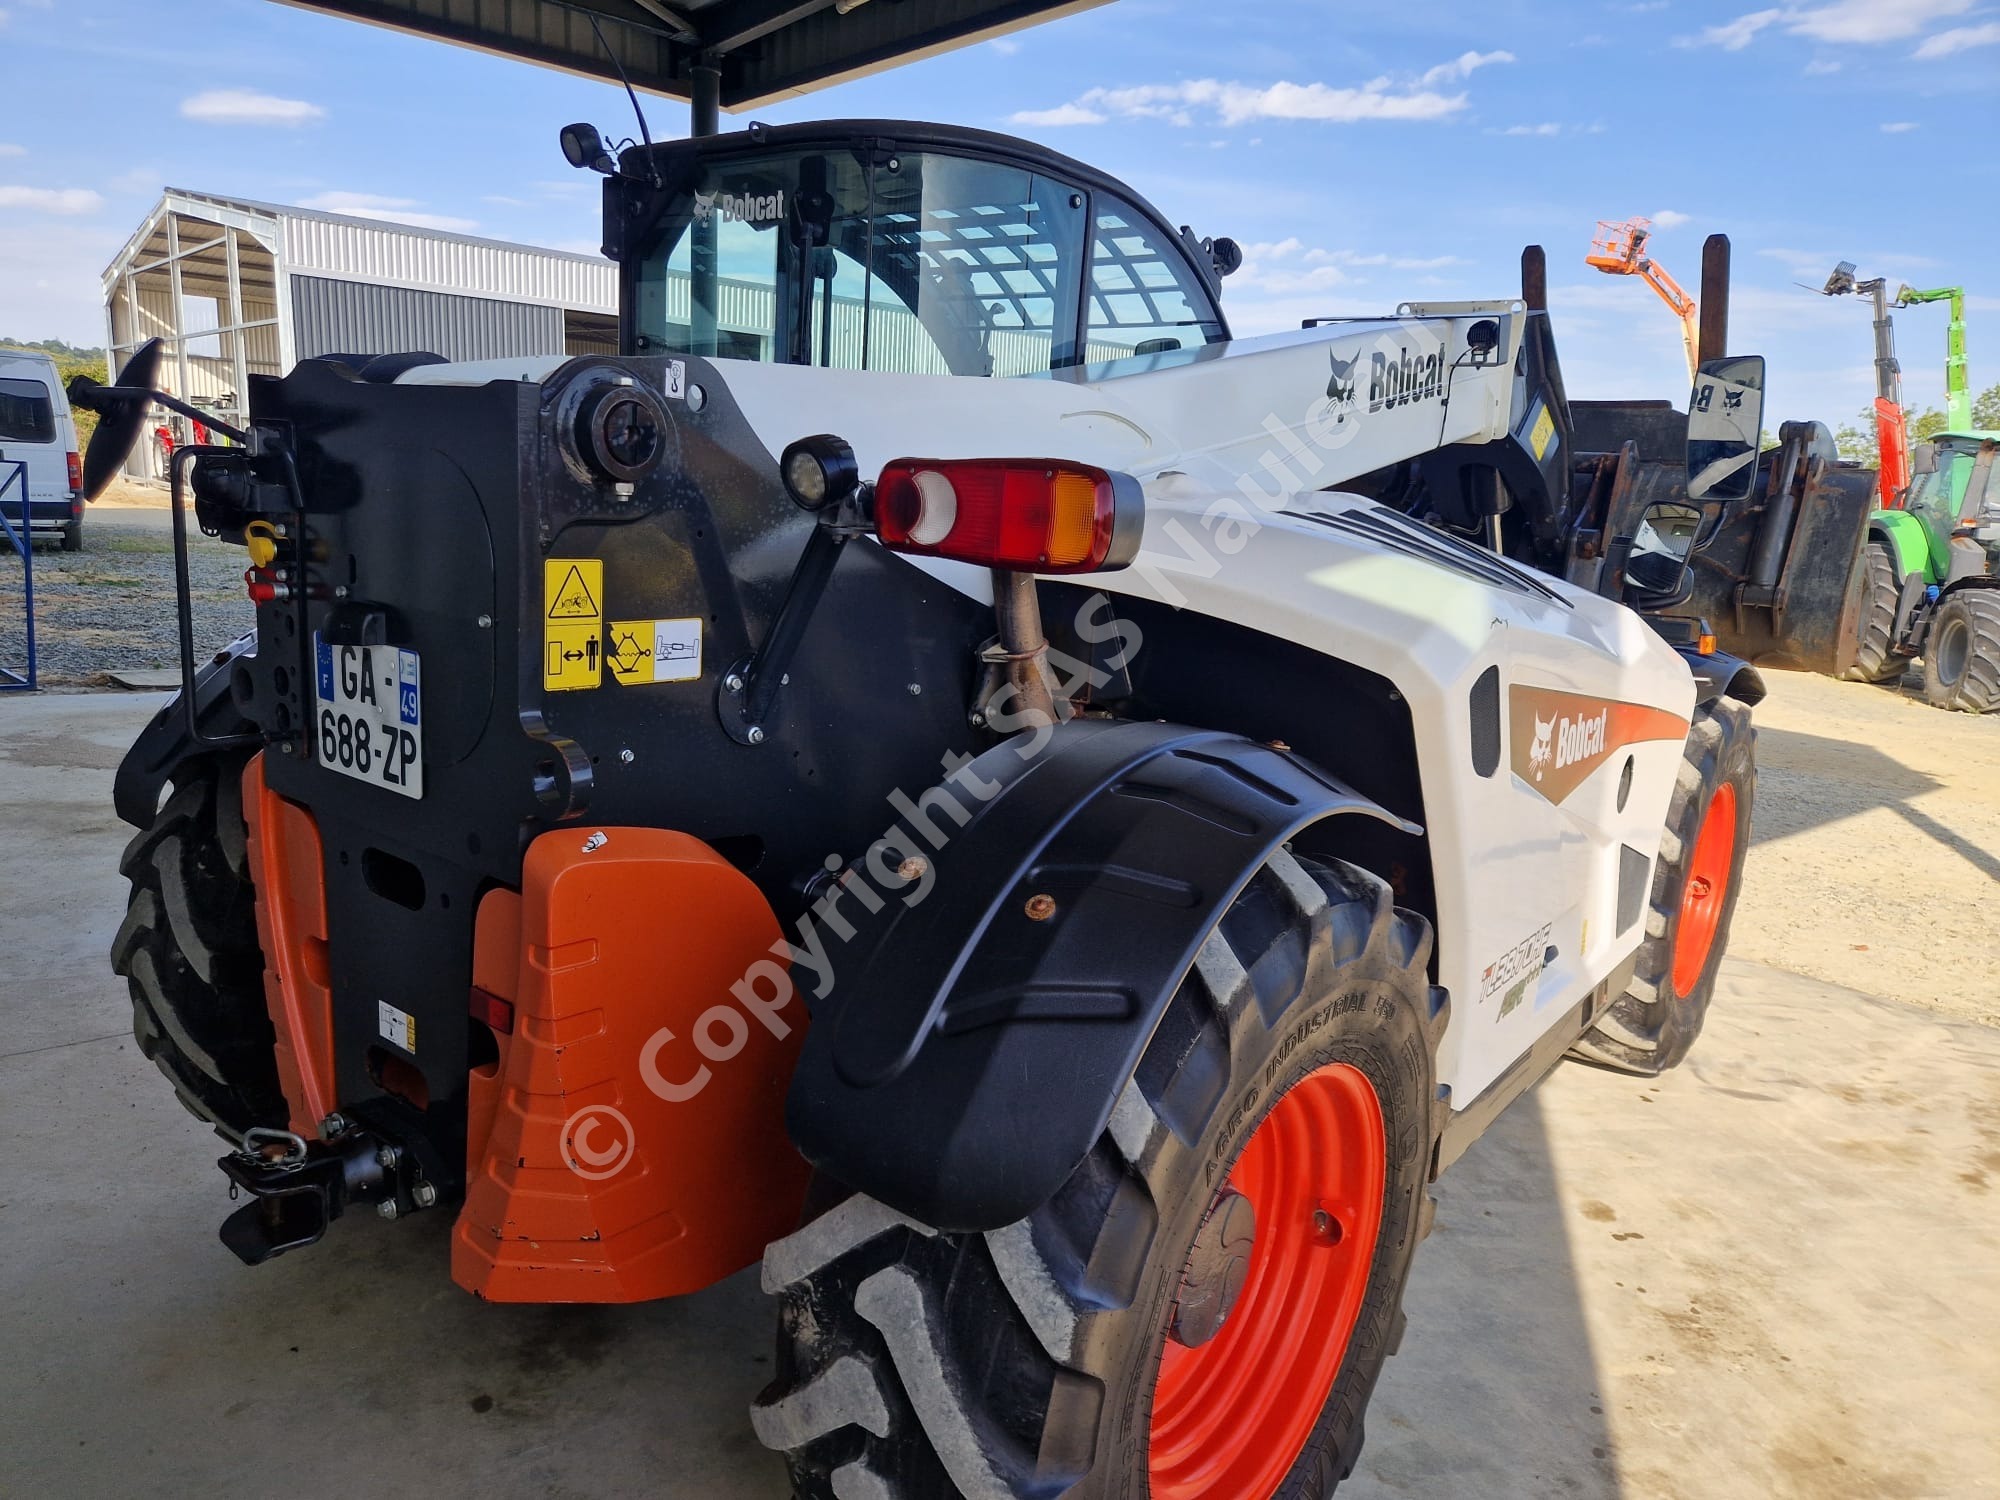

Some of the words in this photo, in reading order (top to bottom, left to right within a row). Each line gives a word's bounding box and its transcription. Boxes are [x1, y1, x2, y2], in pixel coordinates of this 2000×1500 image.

[722, 190, 784, 223] Bobcat
[1369, 342, 1446, 413] Bobcat
[323, 673, 329, 689] F
[401, 690, 417, 718] 49
[321, 709, 417, 787] 688-ZP
[1556, 707, 1608, 769] Bobcat
[1205, 1087, 1259, 1188] AGRO
[1265, 991, 1369, 1087] INDUSTRIAL
